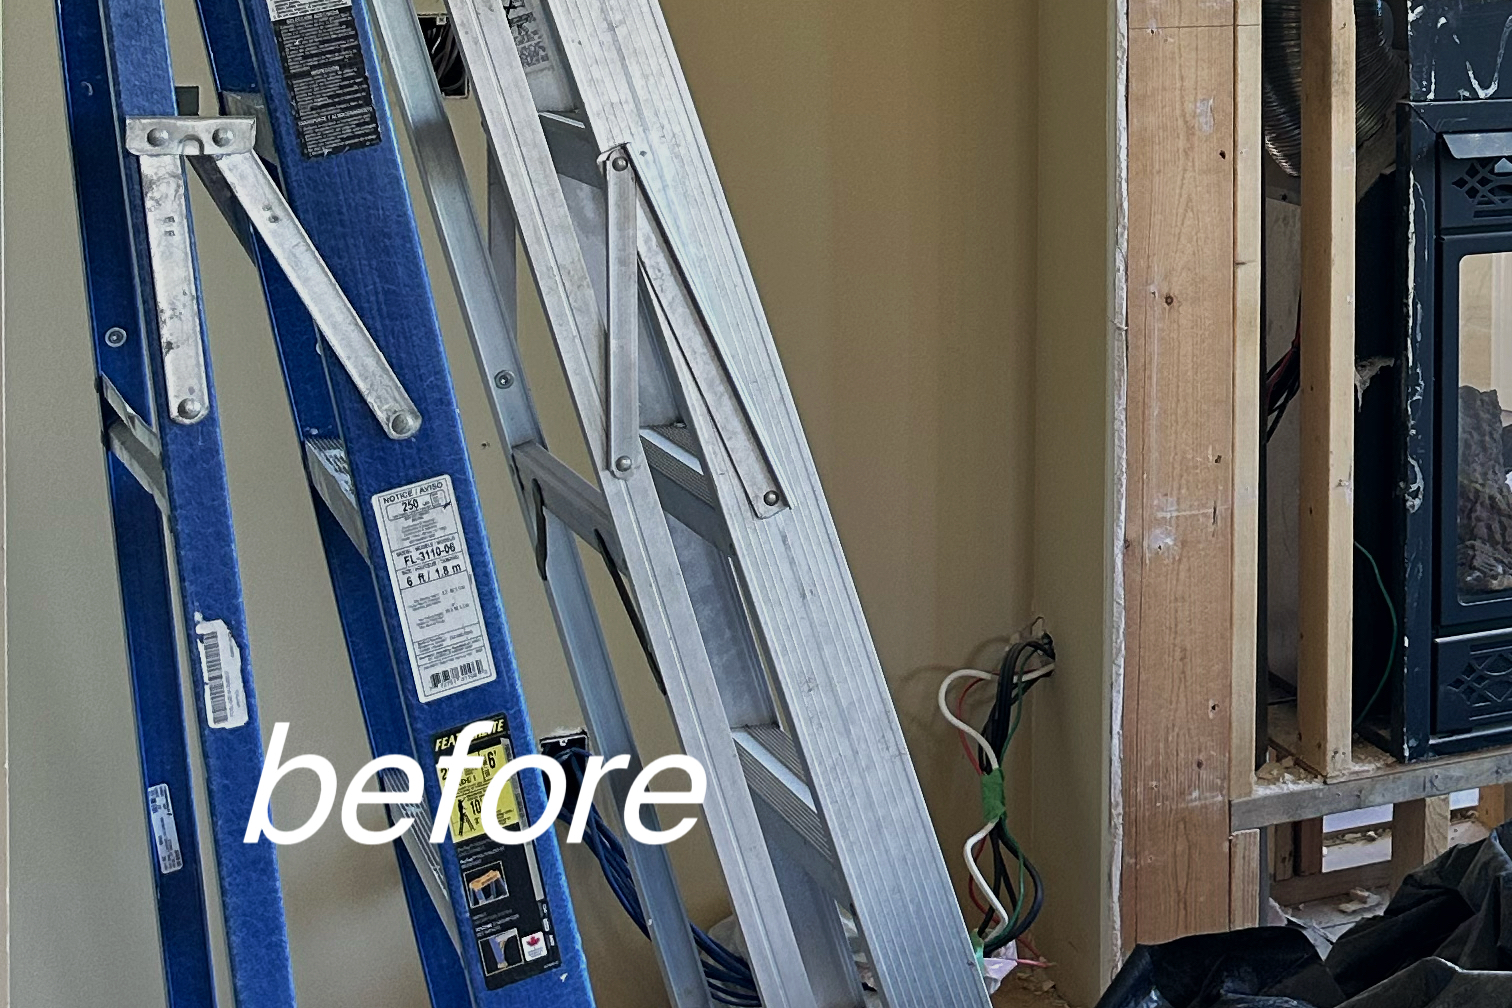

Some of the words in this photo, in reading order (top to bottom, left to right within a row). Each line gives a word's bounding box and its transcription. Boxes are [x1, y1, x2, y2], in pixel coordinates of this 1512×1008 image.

[383, 490, 414, 505] NOTICE
[419, 481, 443, 494] AVISO
[401, 498, 419, 513] 250
[406, 576, 413, 587] 6
[435, 564, 450, 578] 1.8
[451, 563, 461, 572] m
